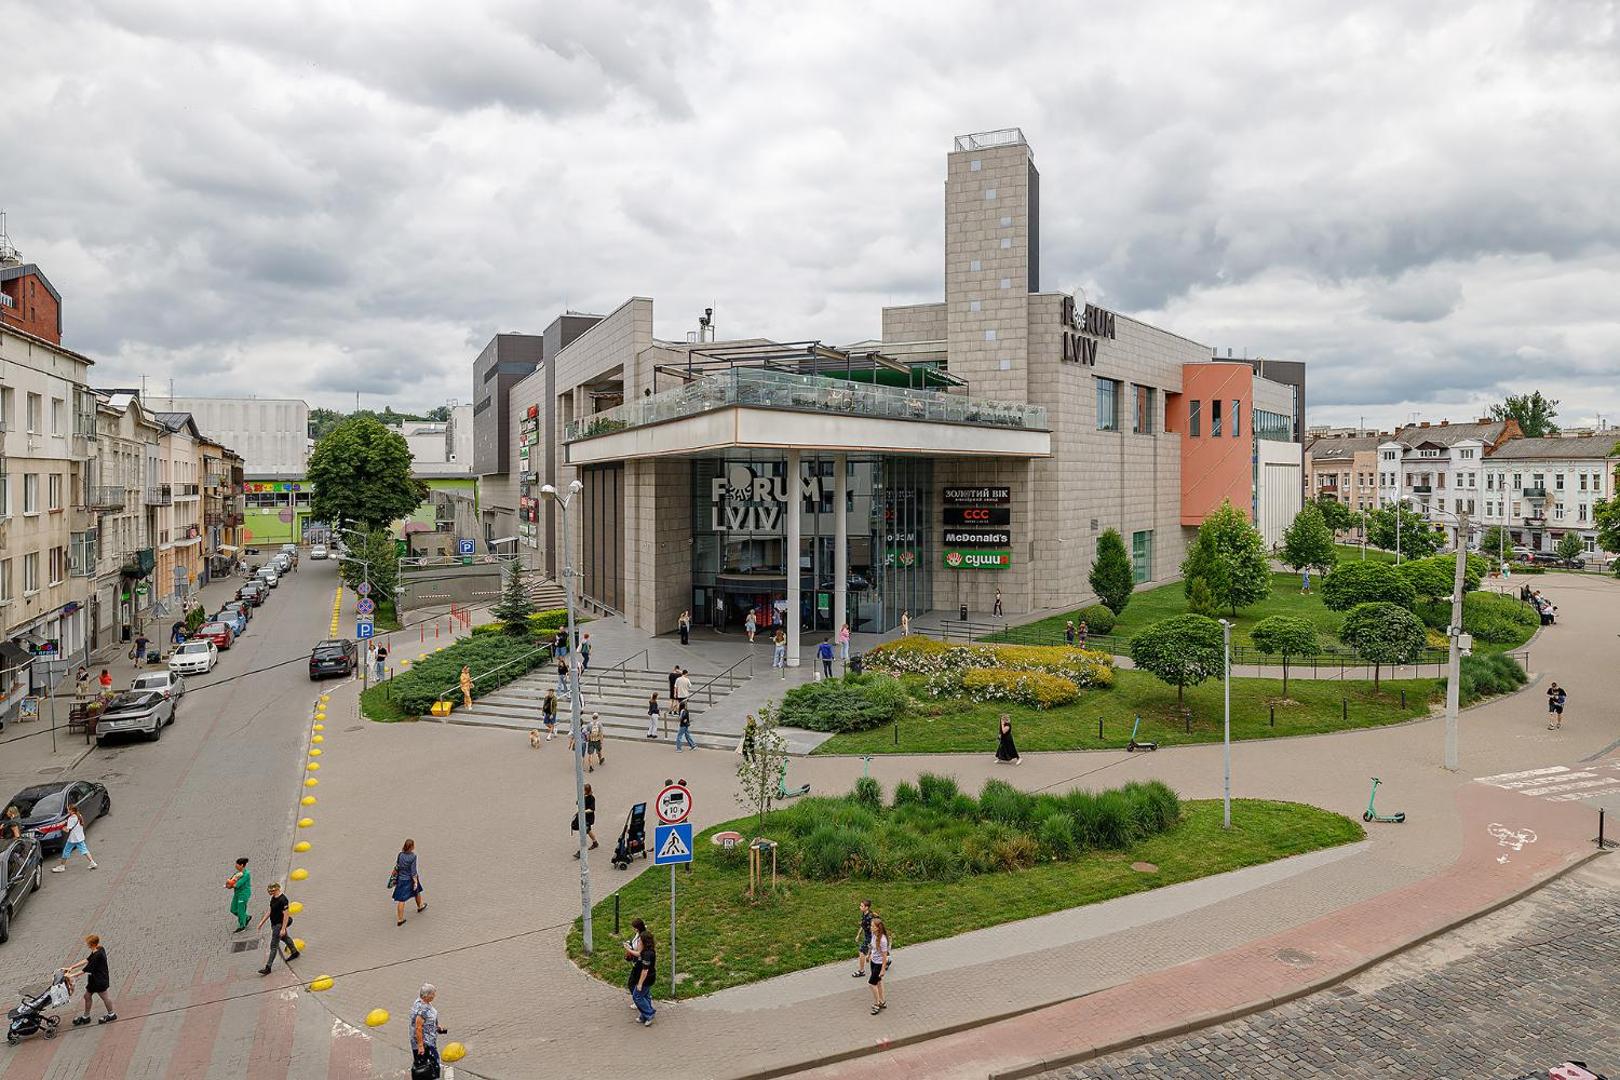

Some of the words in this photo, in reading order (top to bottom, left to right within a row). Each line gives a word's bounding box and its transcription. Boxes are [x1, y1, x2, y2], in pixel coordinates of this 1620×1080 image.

[1063, 288, 1115, 340] FORUM
[1063, 331, 1098, 367] LVIV
[712, 466, 820, 502] FORUM
[945, 487, 989, 498] ЗОЛОТИЙ
[992, 489, 1008, 498] ВІК
[712, 506, 778, 531] LVIV
[963, 510, 989, 519] CCC
[945, 533, 1008, 542] McDonald's
[463, 543, 471, 552] P
[361, 624, 371, 637] P
[670, 806, 678, 814] 10
